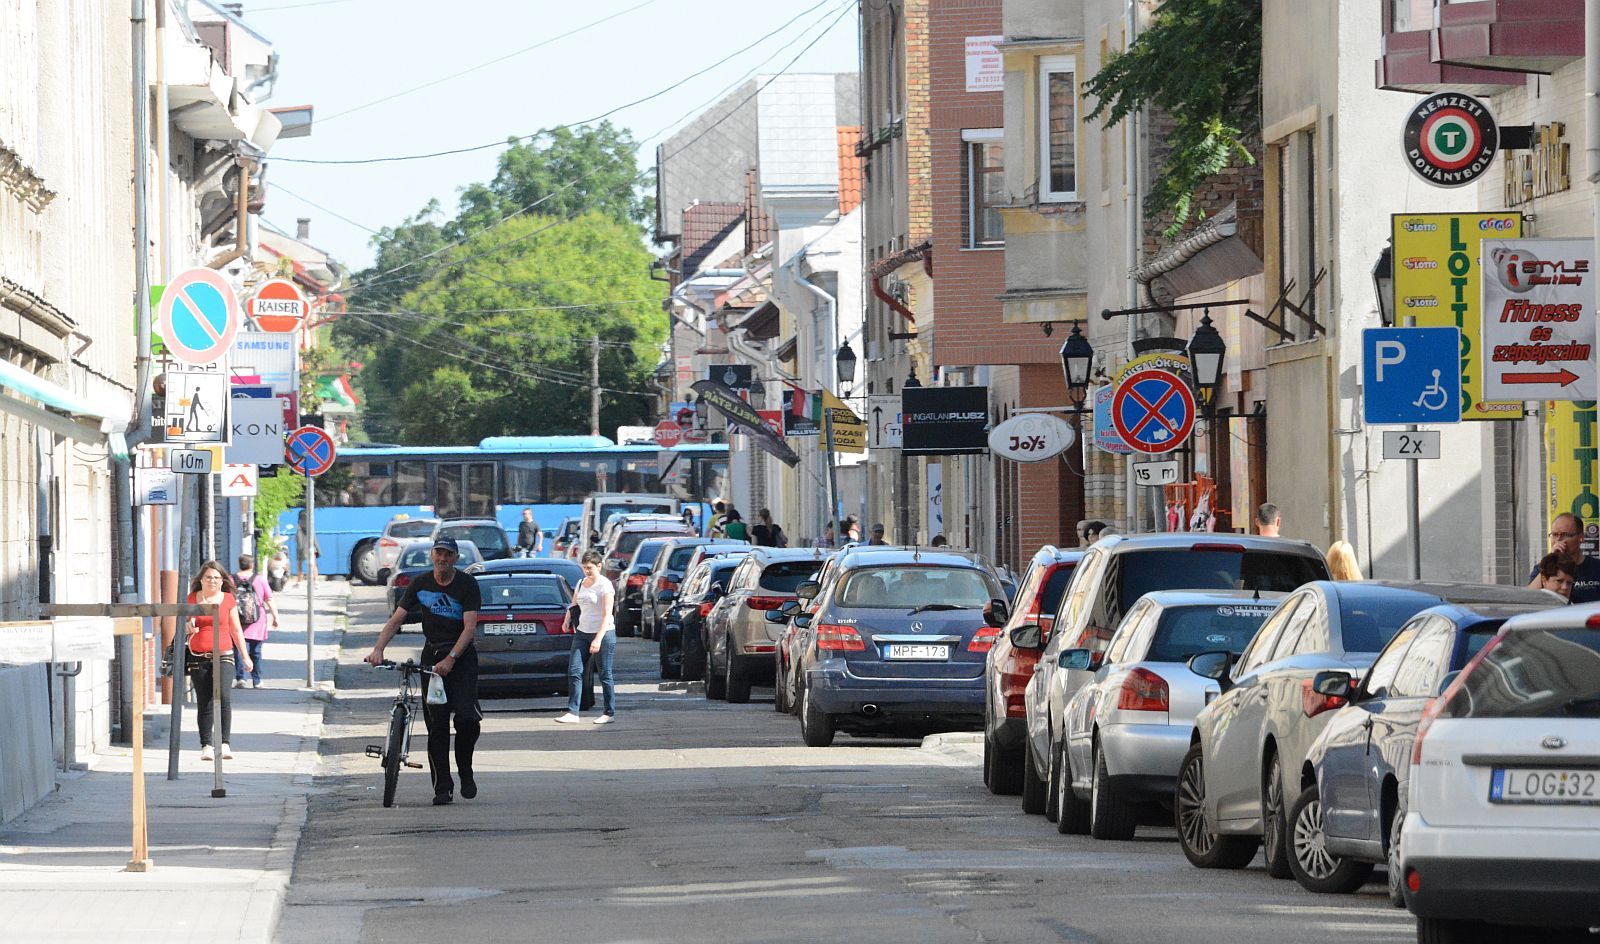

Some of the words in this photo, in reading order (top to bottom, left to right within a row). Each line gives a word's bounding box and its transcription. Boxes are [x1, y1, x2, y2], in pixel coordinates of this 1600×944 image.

[1417, 97, 1483, 119] NEMZETI
[1442, 131, 1461, 148] T
[1409, 146, 1493, 182] DOHÁNYBOLT
[258, 300, 299, 314] KAISER
[1499, 299, 1582, 323] Fitness
[1530, 325, 1553, 341] és
[237, 341, 289, 350] SAMSUNG
[1492, 340, 1591, 365] szépségszalon
[1375, 340, 1406, 382] P
[655, 429, 681, 440] STOP
[1398, 435, 1423, 454] 2x
[179, 453, 204, 469] 10m
[1136, 468, 1151, 480] 15
[1162, 468, 1175, 479] m
[893, 646, 946, 657] MPF-173
